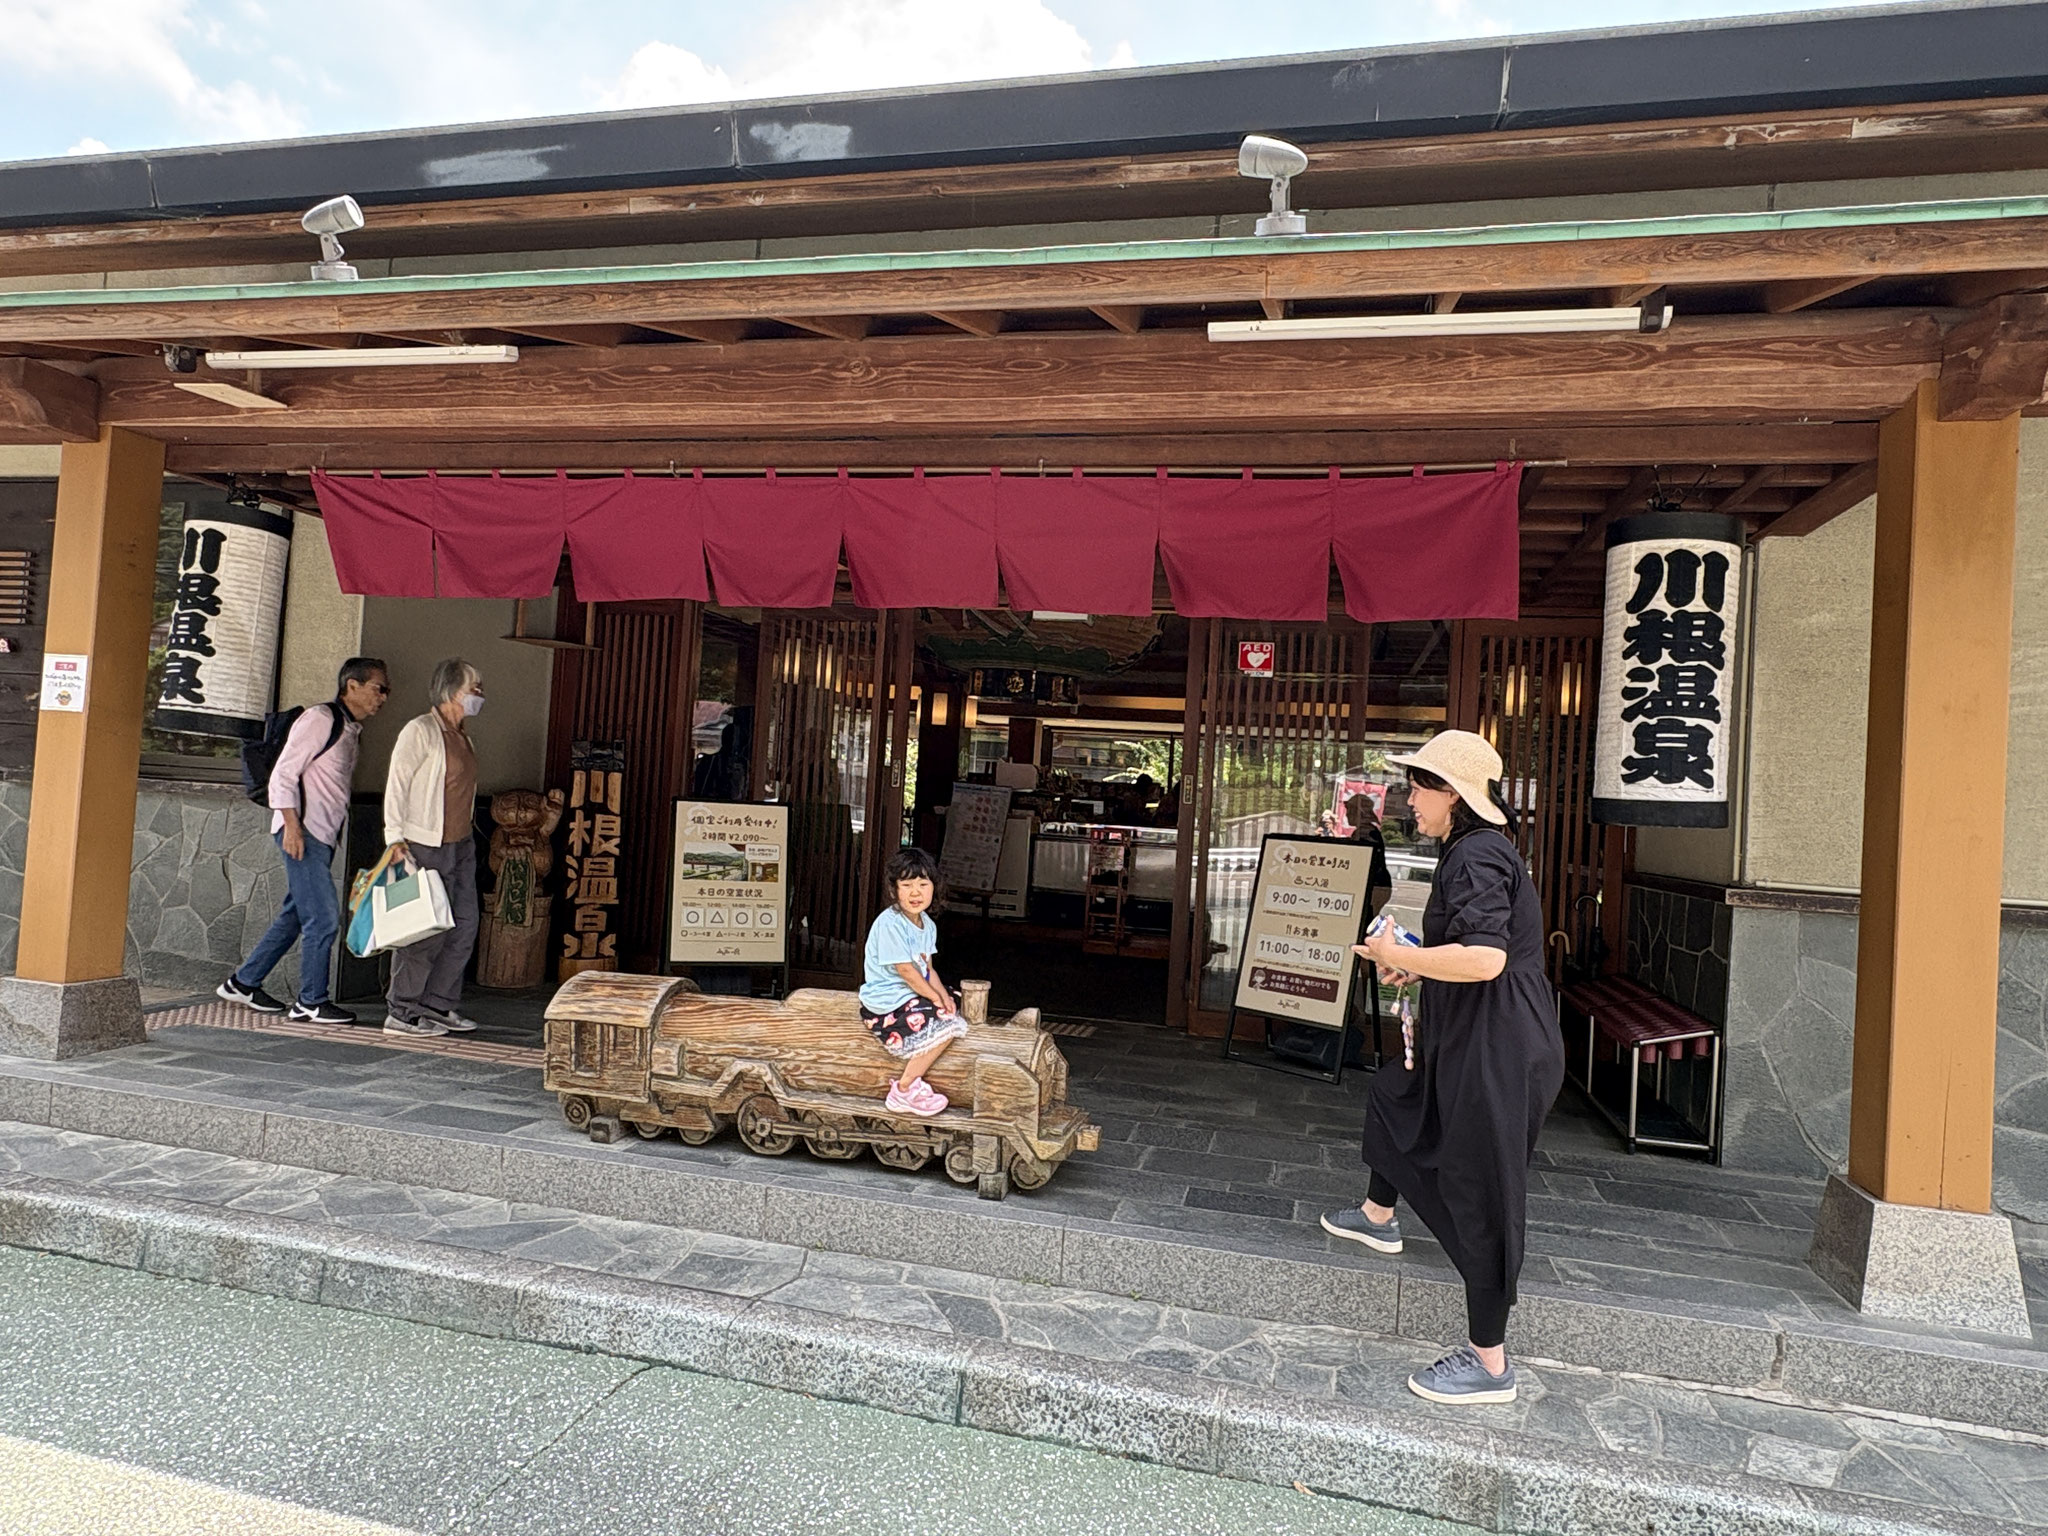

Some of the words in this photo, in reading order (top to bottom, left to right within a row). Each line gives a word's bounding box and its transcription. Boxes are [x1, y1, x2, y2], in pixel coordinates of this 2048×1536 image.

[1242, 643, 1272, 652] AED
[1621, 549, 1729, 790] 川根温泉
[702, 832, 727, 842] 2時間
[563, 770, 622, 958] 川根温泉
[1282, 853, 1351, 870] 本日の営業時間
[698, 887, 764, 898] 本日の空室状況
[1317, 897, 1350, 912] 19:00
[1293, 926, 1320, 938] お食事
[1308, 948, 1341, 964] 18:00
